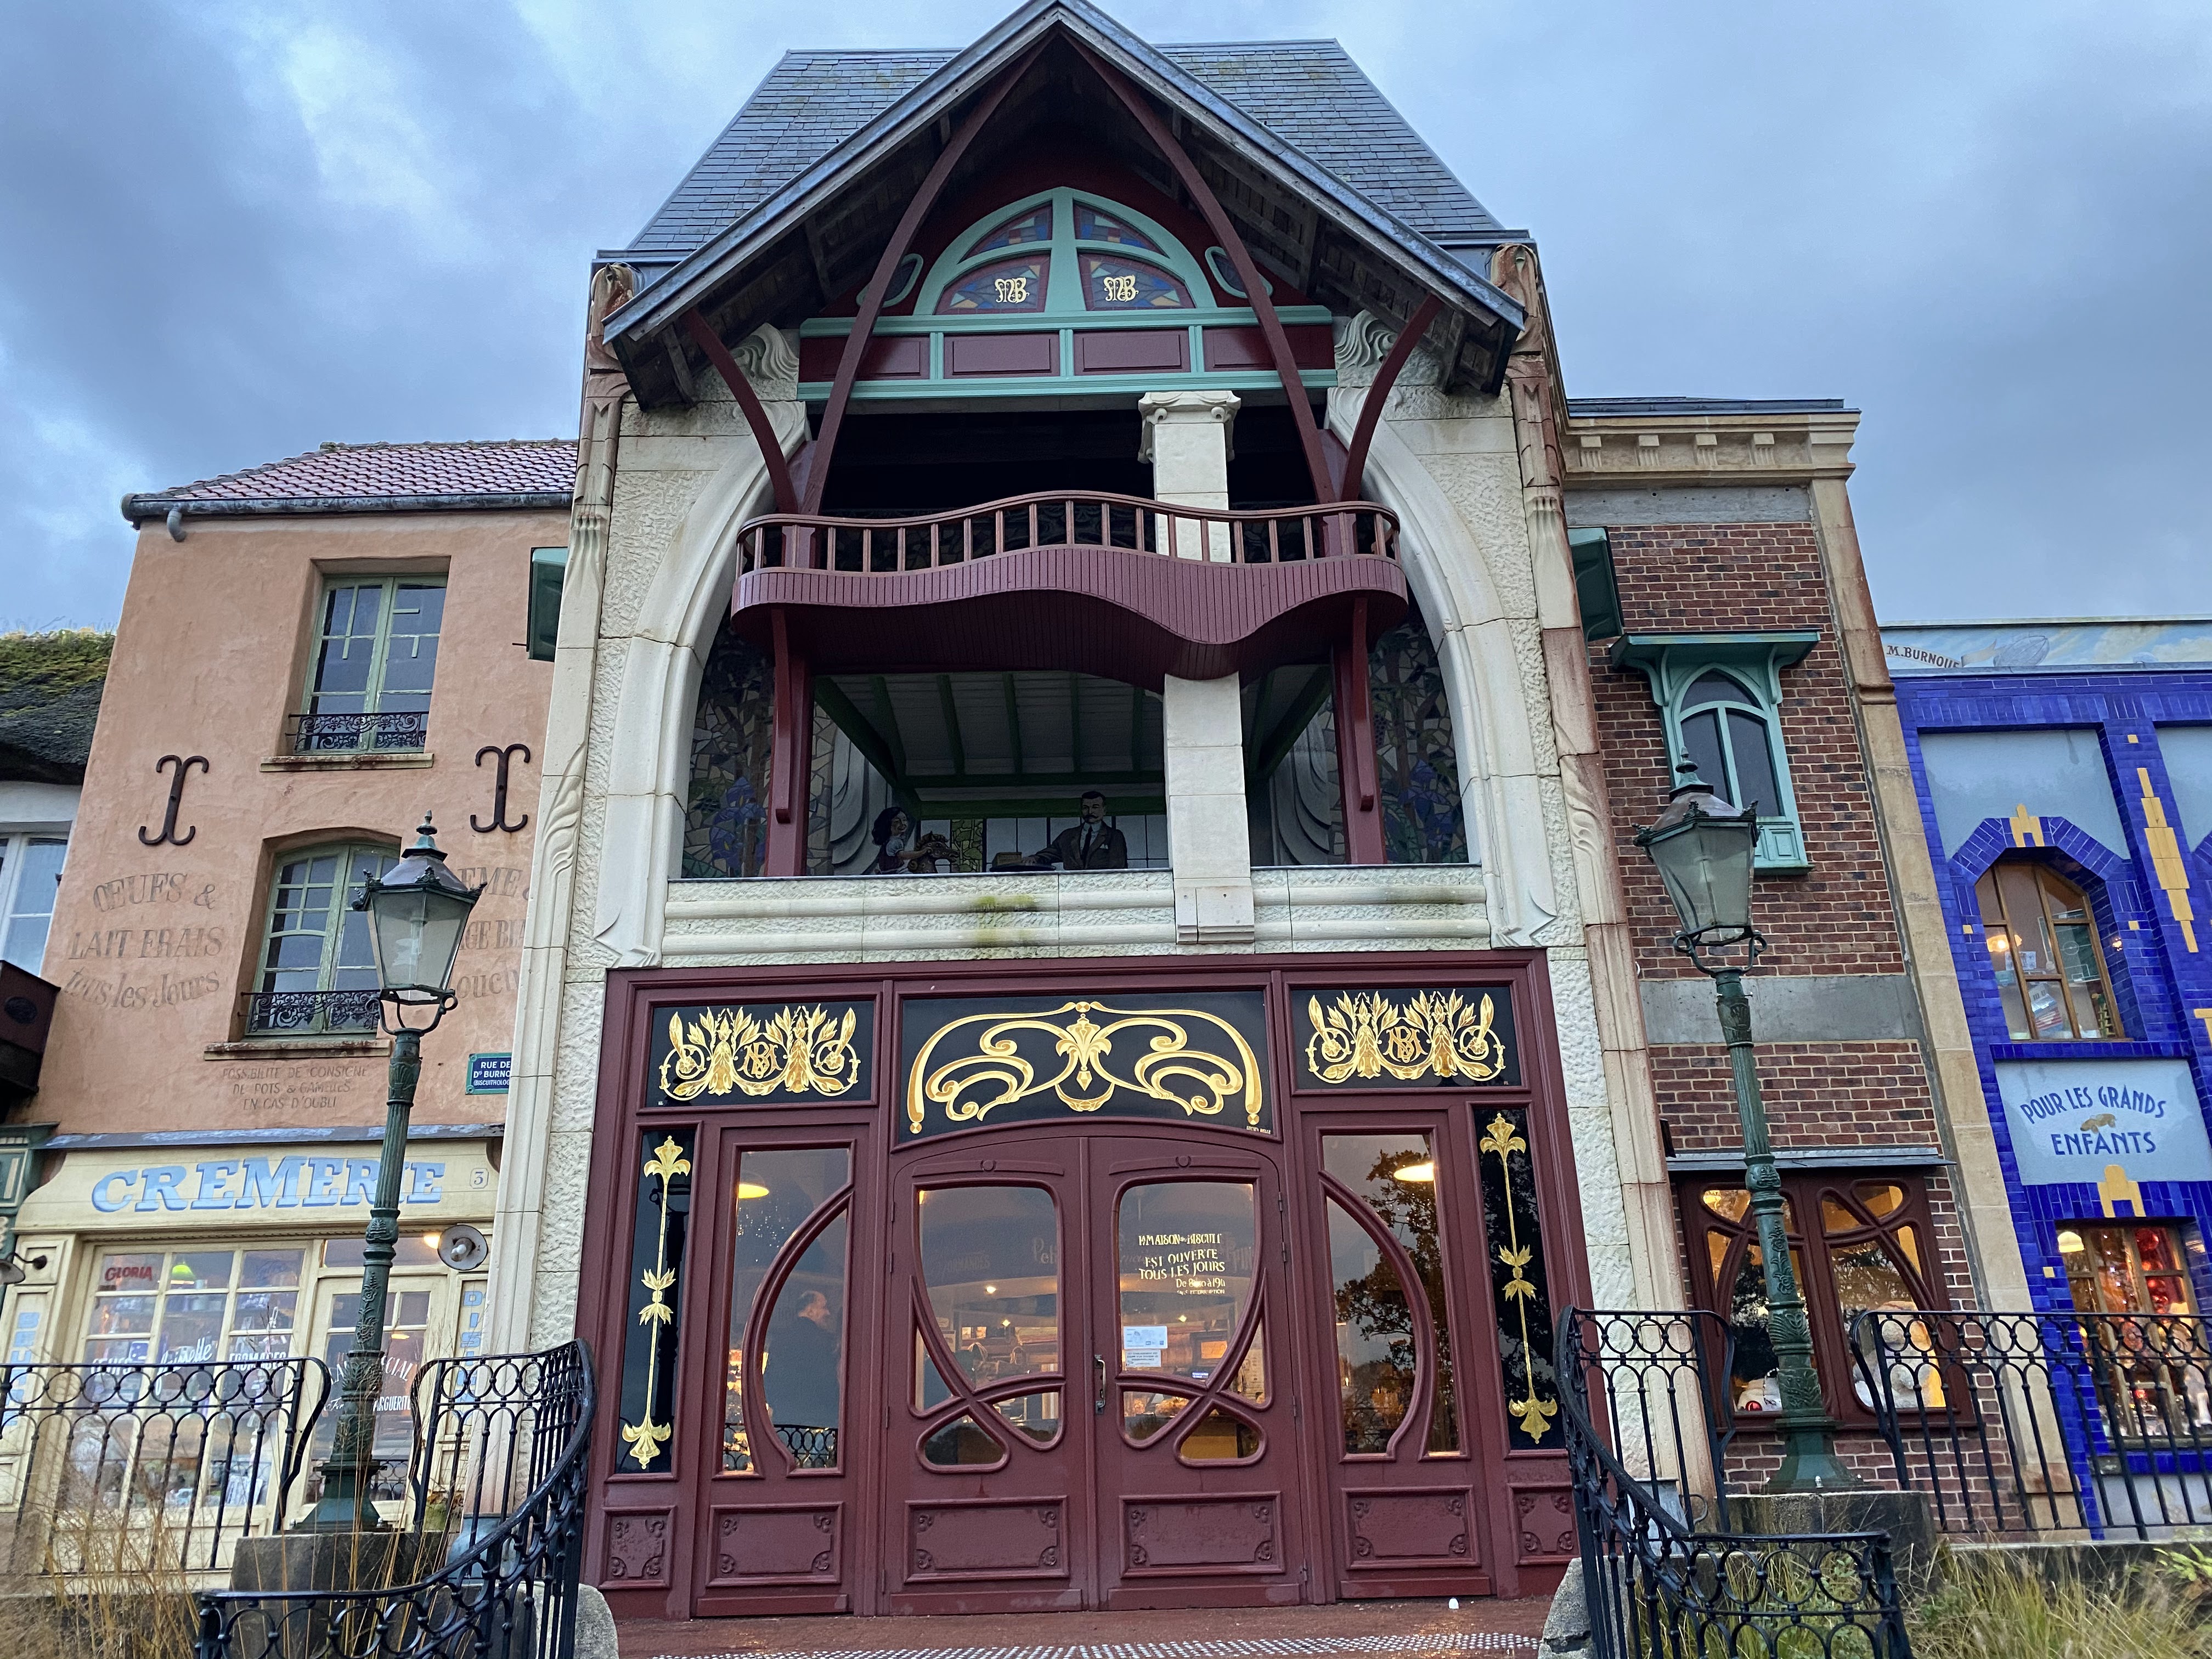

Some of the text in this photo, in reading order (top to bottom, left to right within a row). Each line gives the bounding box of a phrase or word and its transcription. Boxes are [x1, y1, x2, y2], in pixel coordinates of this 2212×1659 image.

[194, 884, 215, 909] &
[68, 927, 224, 960] LAIT FRAIS
[110, 973, 146, 1008] les
[289, 1067, 302, 1079] DE
[233, 1084, 245, 1094] DE
[255, 1083, 280, 1094] POTS
[243, 1098, 258, 1110] EN
[263, 1098, 284, 1109] CAS
[2020, 1085, 2166, 1124] POUR LES GRANDS
[2051, 1132, 2156, 1155] ENFANTS
[92, 1156, 445, 1212] CREMERE
[474, 1171, 484, 1185] 3
[1167, 1248, 1218, 1265] OUVERTE
[1139, 1261, 1225, 1280] TOUS LES JOURS
[1176, 1278, 1187, 1288] De
